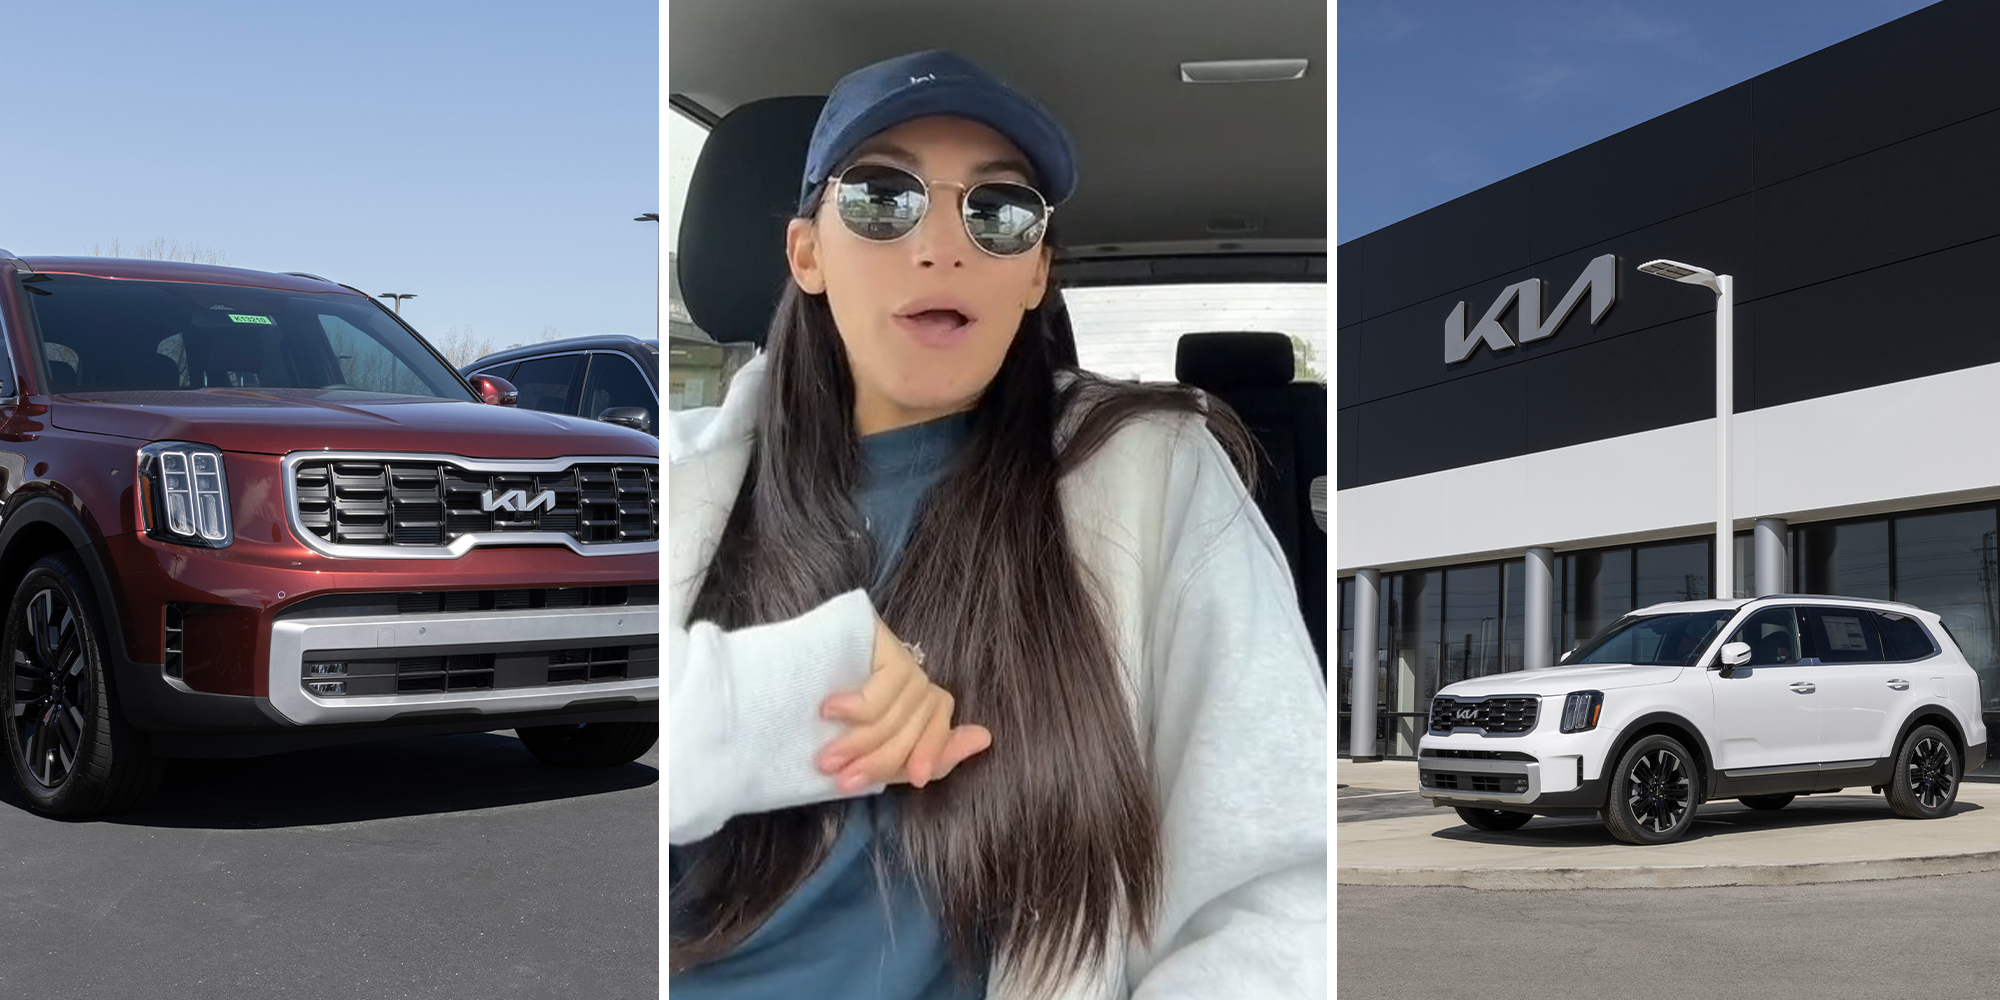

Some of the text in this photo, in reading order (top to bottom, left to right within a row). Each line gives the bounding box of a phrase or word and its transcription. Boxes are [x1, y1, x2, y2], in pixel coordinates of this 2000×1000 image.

[1445, 253, 1615, 364] KIA
[481, 489, 556, 514] KIA
[1456, 709, 1478, 719] KIA
